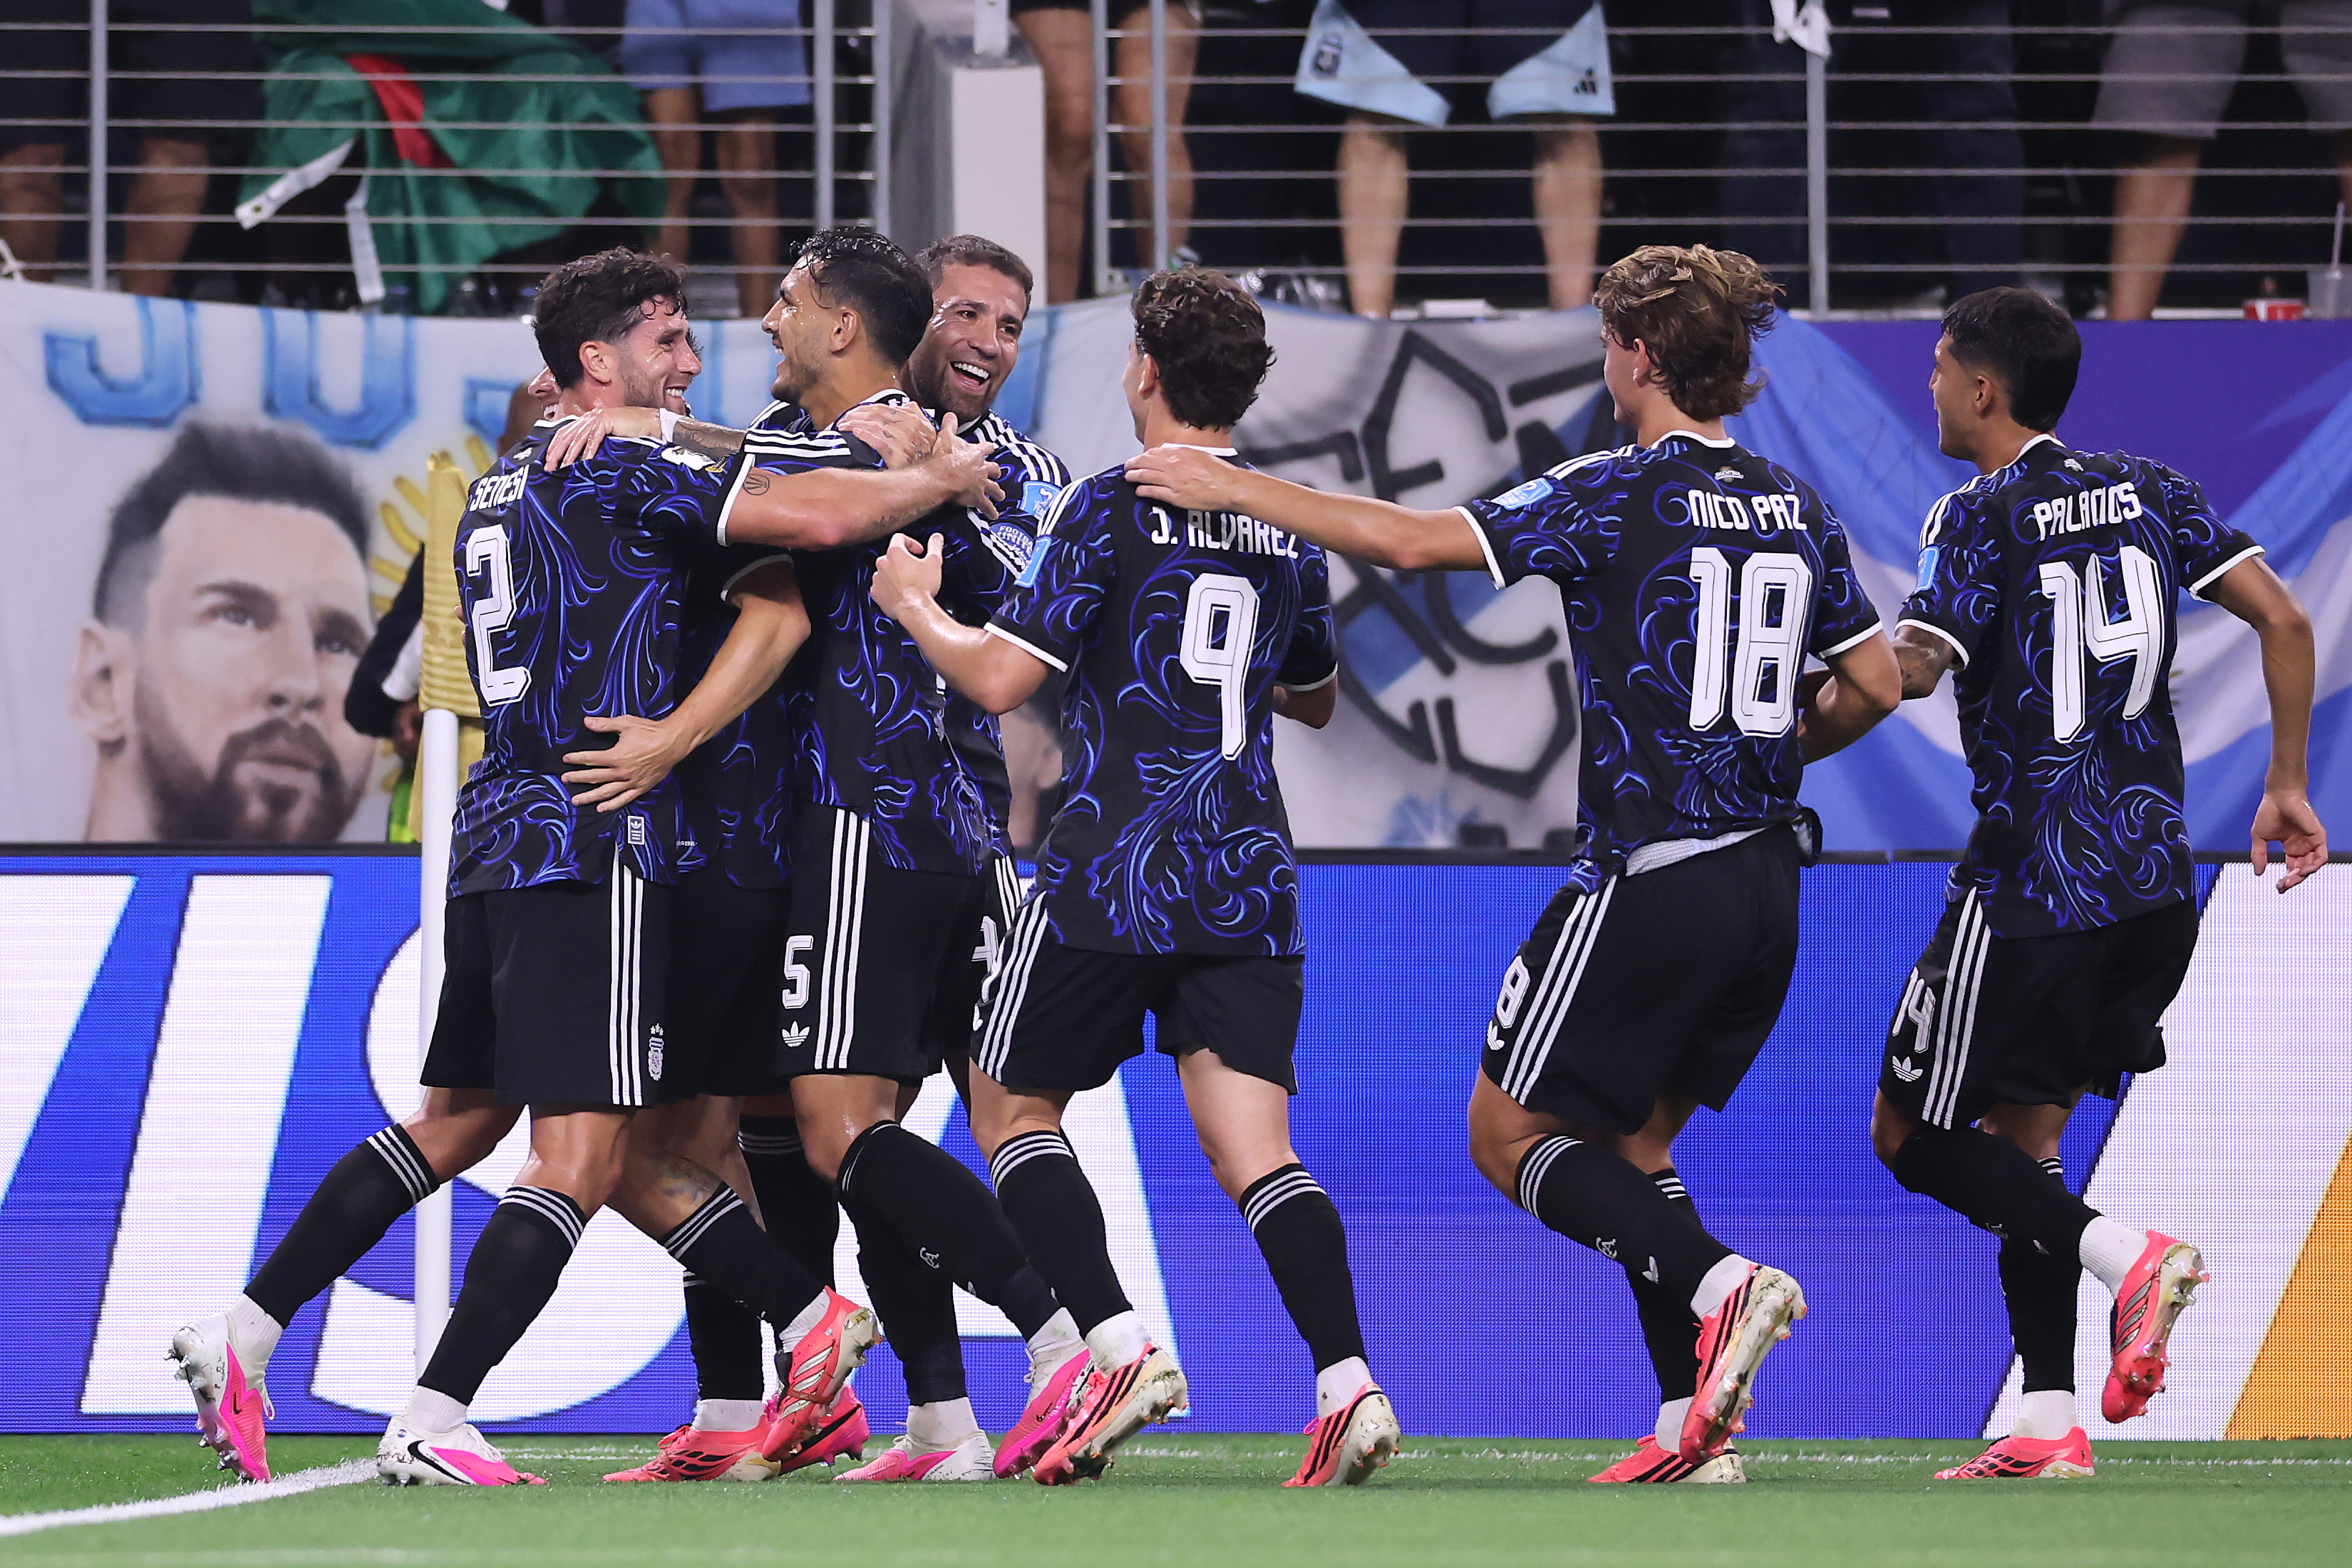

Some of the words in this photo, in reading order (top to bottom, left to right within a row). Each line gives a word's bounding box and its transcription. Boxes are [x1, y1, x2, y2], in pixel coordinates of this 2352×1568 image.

[470, 465, 530, 511] SENESI
[1688, 490, 1750, 530] NICO
[1751, 494, 1807, 530] PAZ
[2033, 482, 2142, 541] PALACIOS
[997, 531, 1033, 557] UNITE
[999, 525, 1033, 547] FOOTBA
[1151, 506, 1177, 544] J.
[466, 524, 532, 706] 2
[1689, 547, 1812, 738] 18
[2039, 545, 2165, 743] 14
[1180, 572, 1260, 760] 9
[783, 935, 813, 1009] 5
[1892, 966, 1936, 1053] 14
